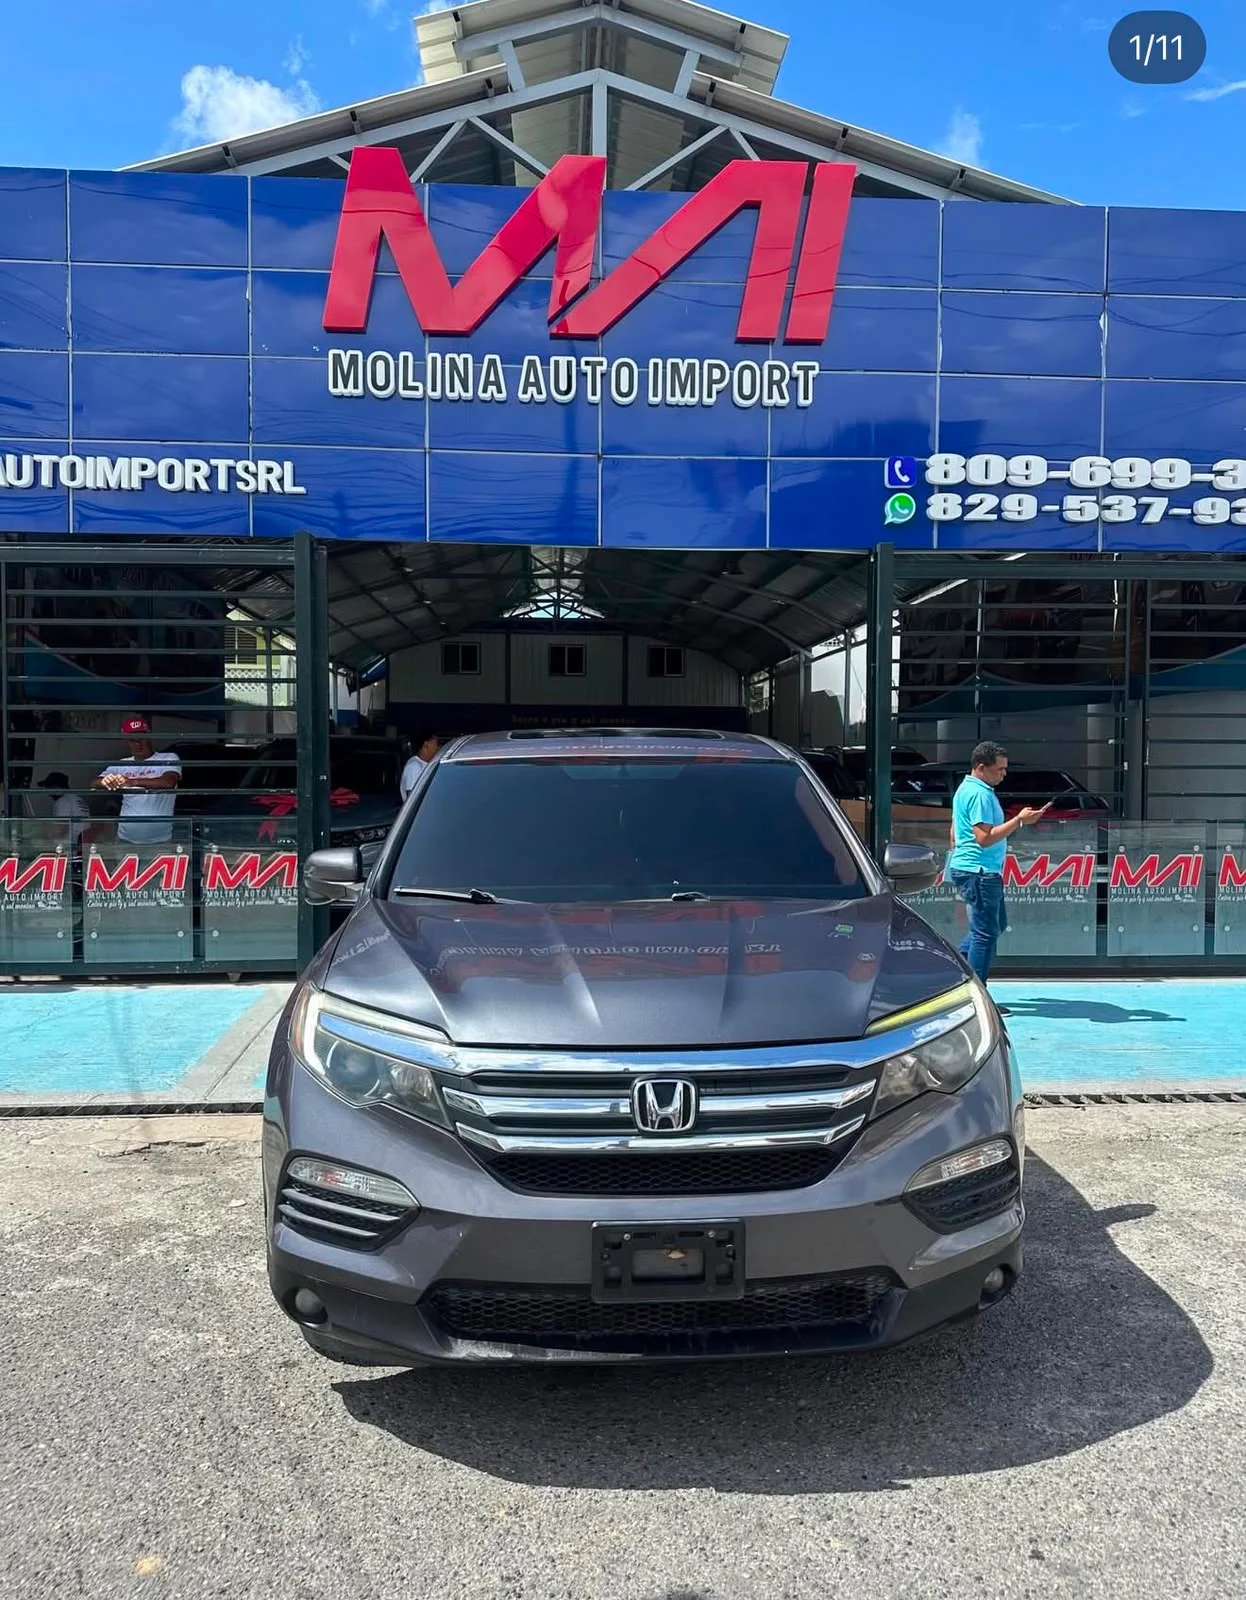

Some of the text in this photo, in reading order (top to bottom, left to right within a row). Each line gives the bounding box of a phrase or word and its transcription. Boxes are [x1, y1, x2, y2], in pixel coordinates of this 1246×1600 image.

[328, 349, 820, 408] MOLINA AUTO IMPORT
